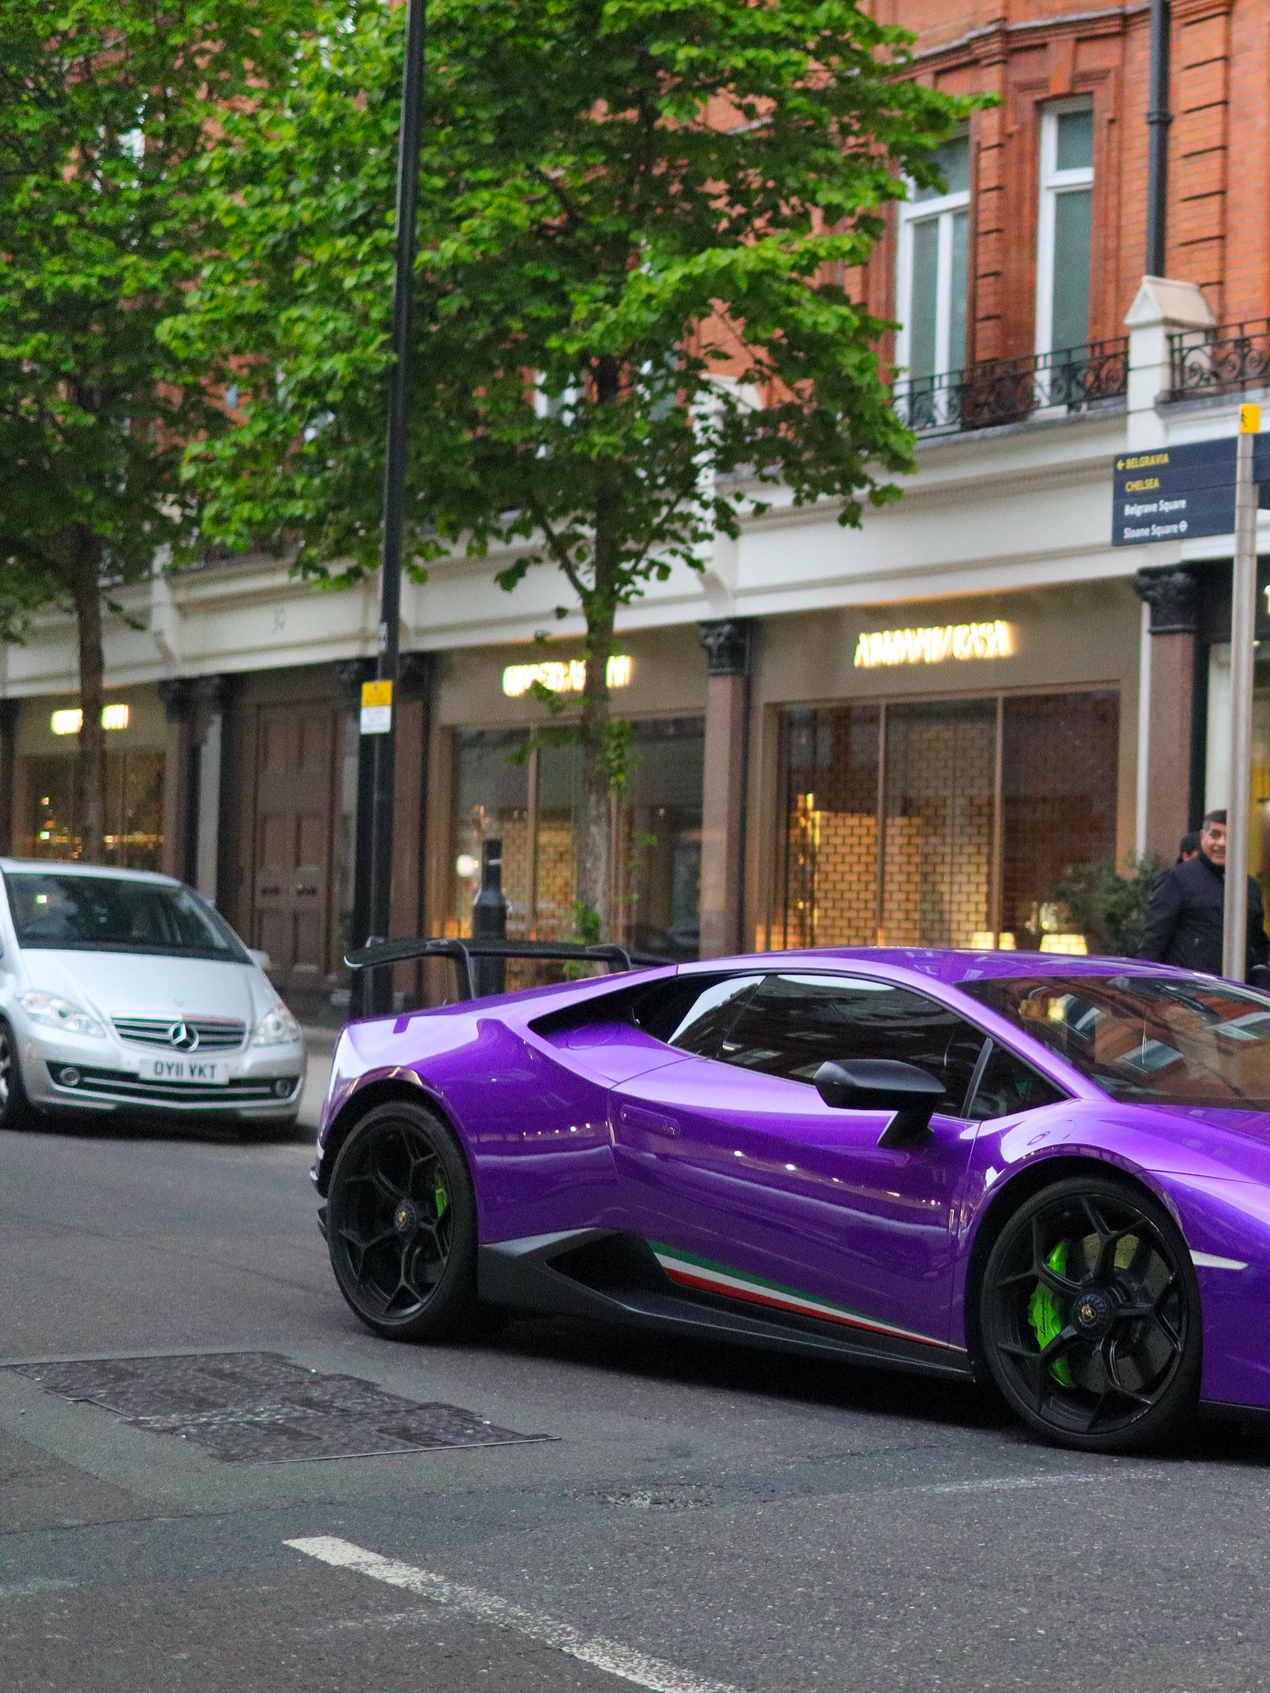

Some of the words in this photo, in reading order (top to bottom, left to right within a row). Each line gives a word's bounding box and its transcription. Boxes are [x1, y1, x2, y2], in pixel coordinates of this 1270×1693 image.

[1126, 453, 1169, 469] BELGRAVIA
[1125, 478, 1159, 492] CHELSEA
[1124, 503, 1158, 517] Belgrave
[1159, 499, 1186, 512] Square
[1123, 527, 1150, 539] Sloane
[1151, 524, 1178, 537] Square
